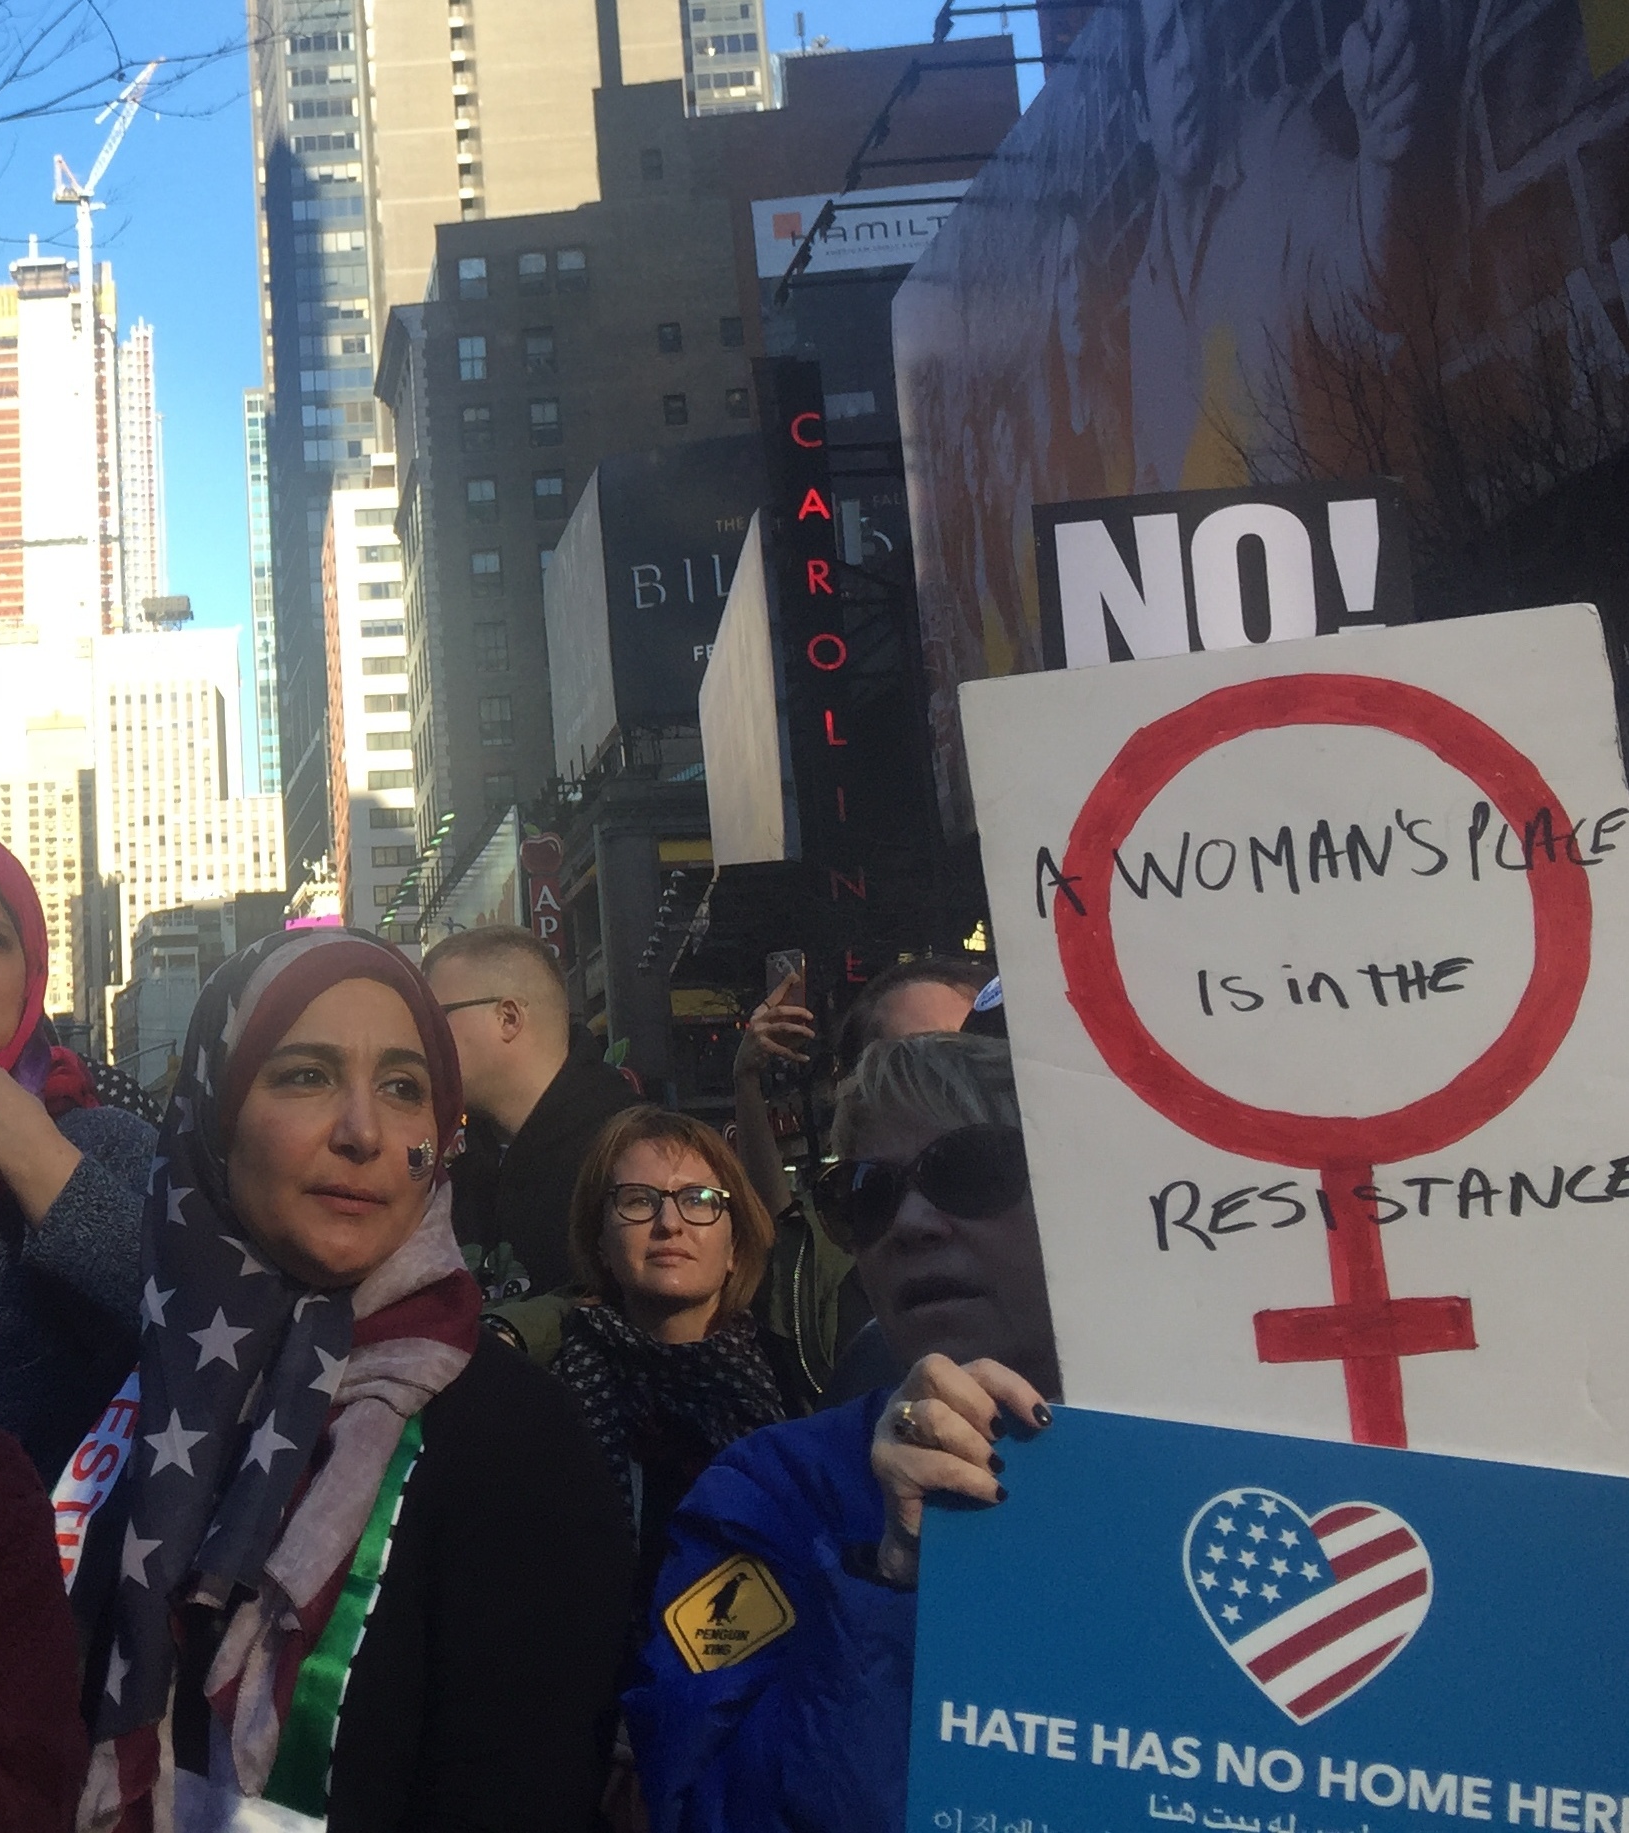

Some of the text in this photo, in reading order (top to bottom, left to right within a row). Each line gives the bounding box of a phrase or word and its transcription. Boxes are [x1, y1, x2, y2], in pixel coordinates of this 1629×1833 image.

[1054, 498, 1387, 669] NO!
[1034, 801, 1629, 919] A WOMAN'S PLACE
[1356, 956, 1475, 1008] THE
[1148, 1154, 1629, 1252] RESISTANCE
[939, 1699, 1078, 1763] HATE
[1090, 1722, 1203, 1781] HAS
[1214, 1742, 1305, 1795] NO
[1318, 1756, 1493, 1823] HOME
